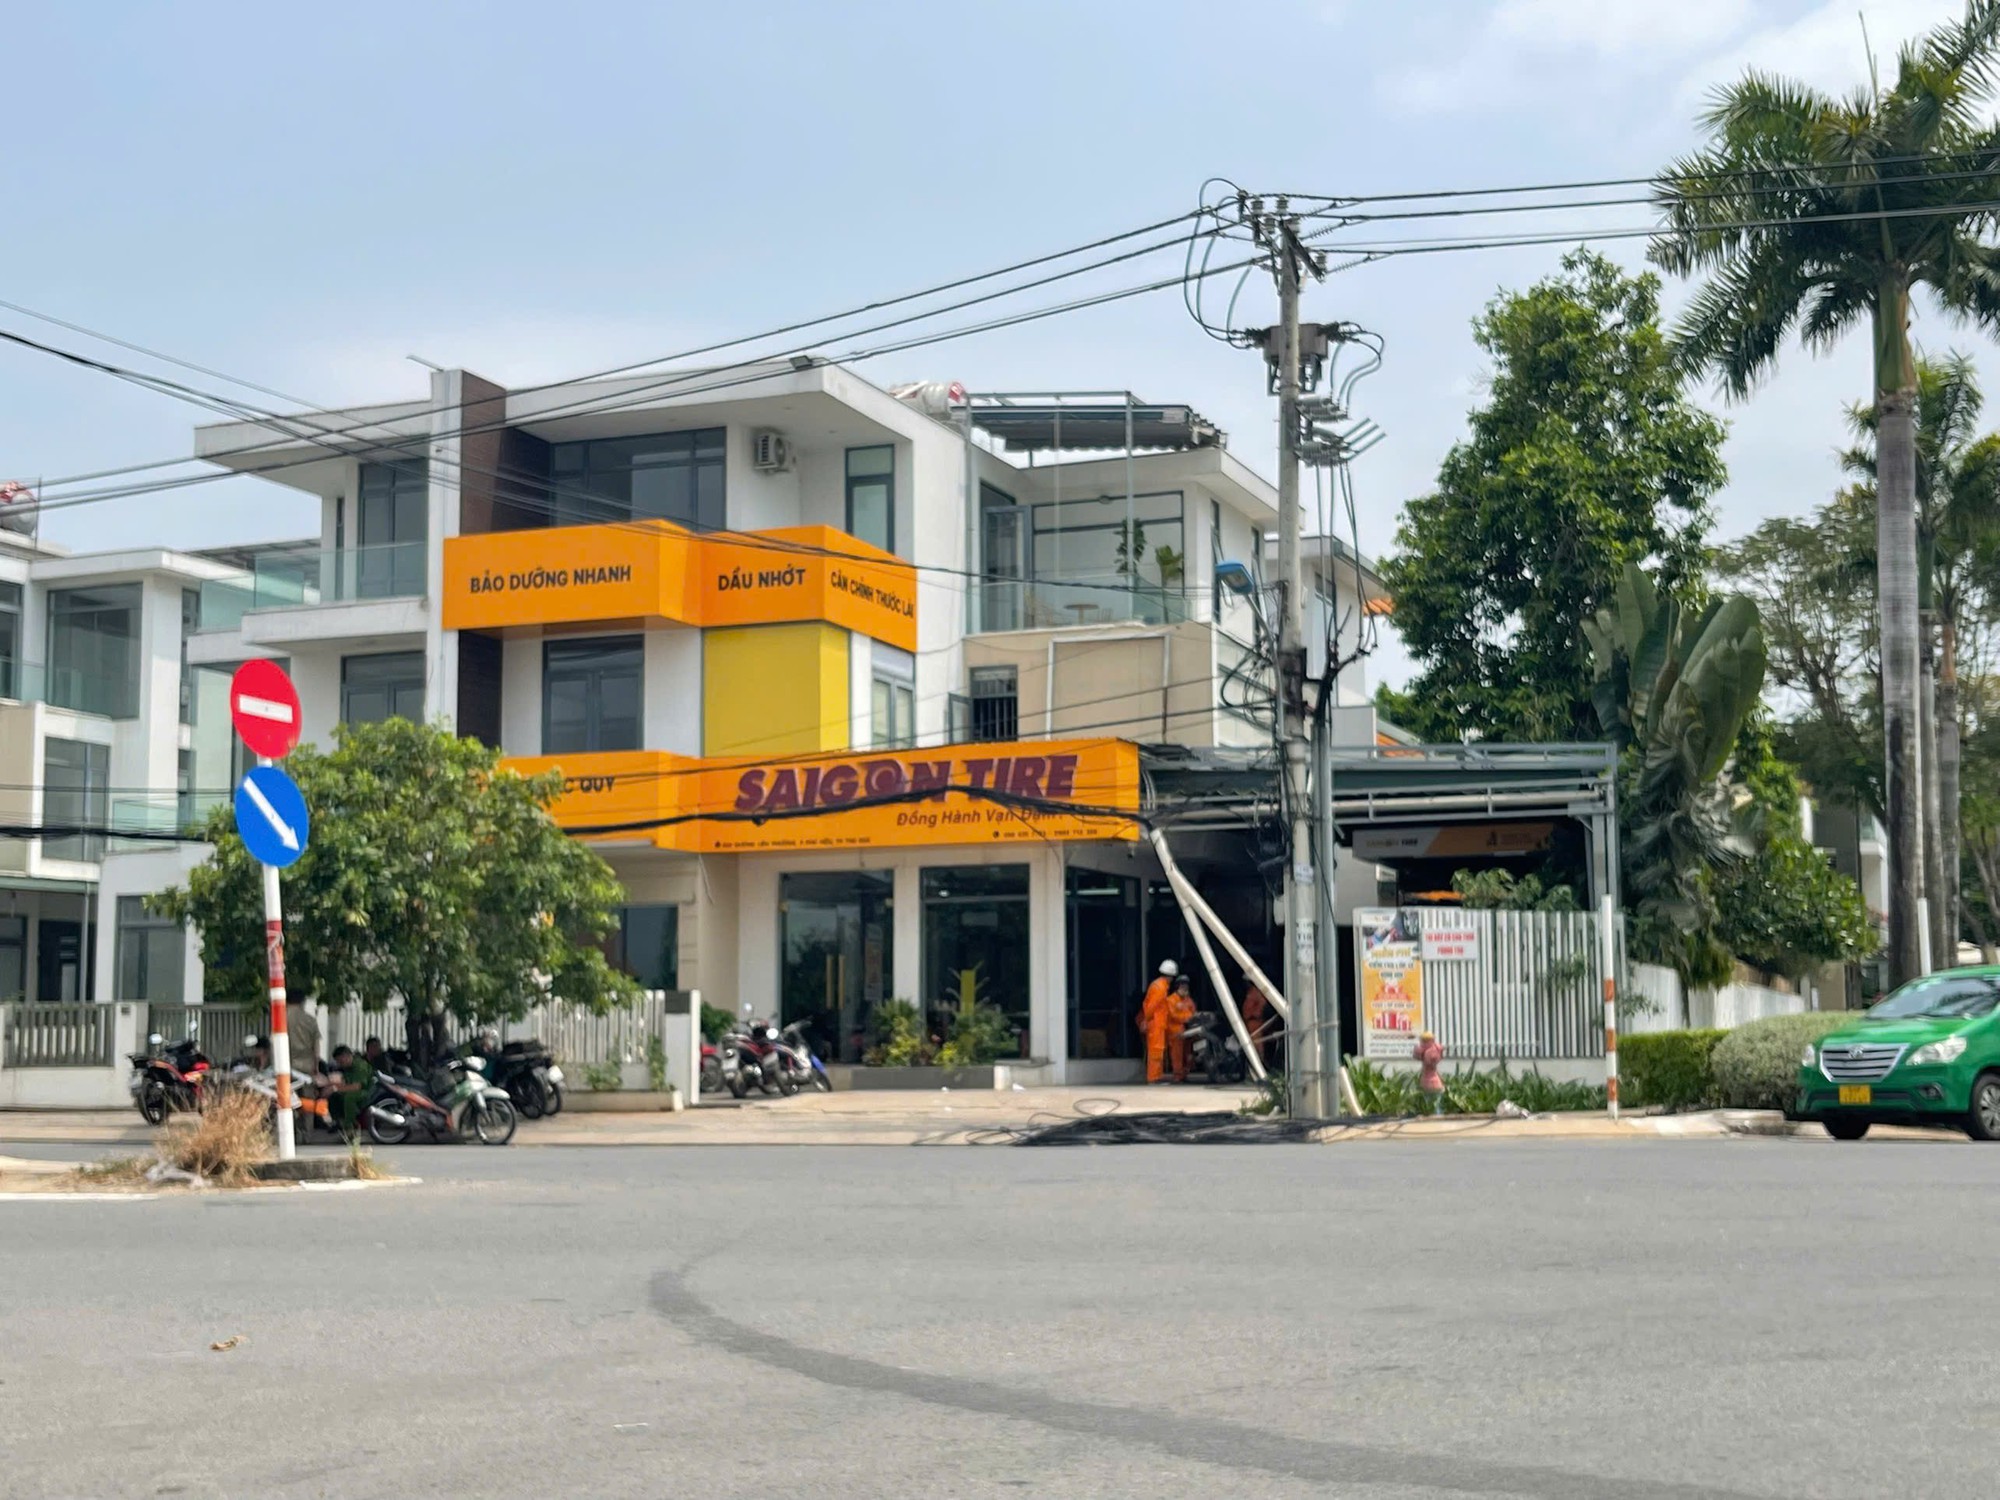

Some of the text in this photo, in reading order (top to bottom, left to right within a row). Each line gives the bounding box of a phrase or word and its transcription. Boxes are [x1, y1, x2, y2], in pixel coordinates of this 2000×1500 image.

[573, 565, 631, 586] NHANH
[734, 754, 1078, 812] SAIGON TIRE
[941, 809, 981, 824] Hành
